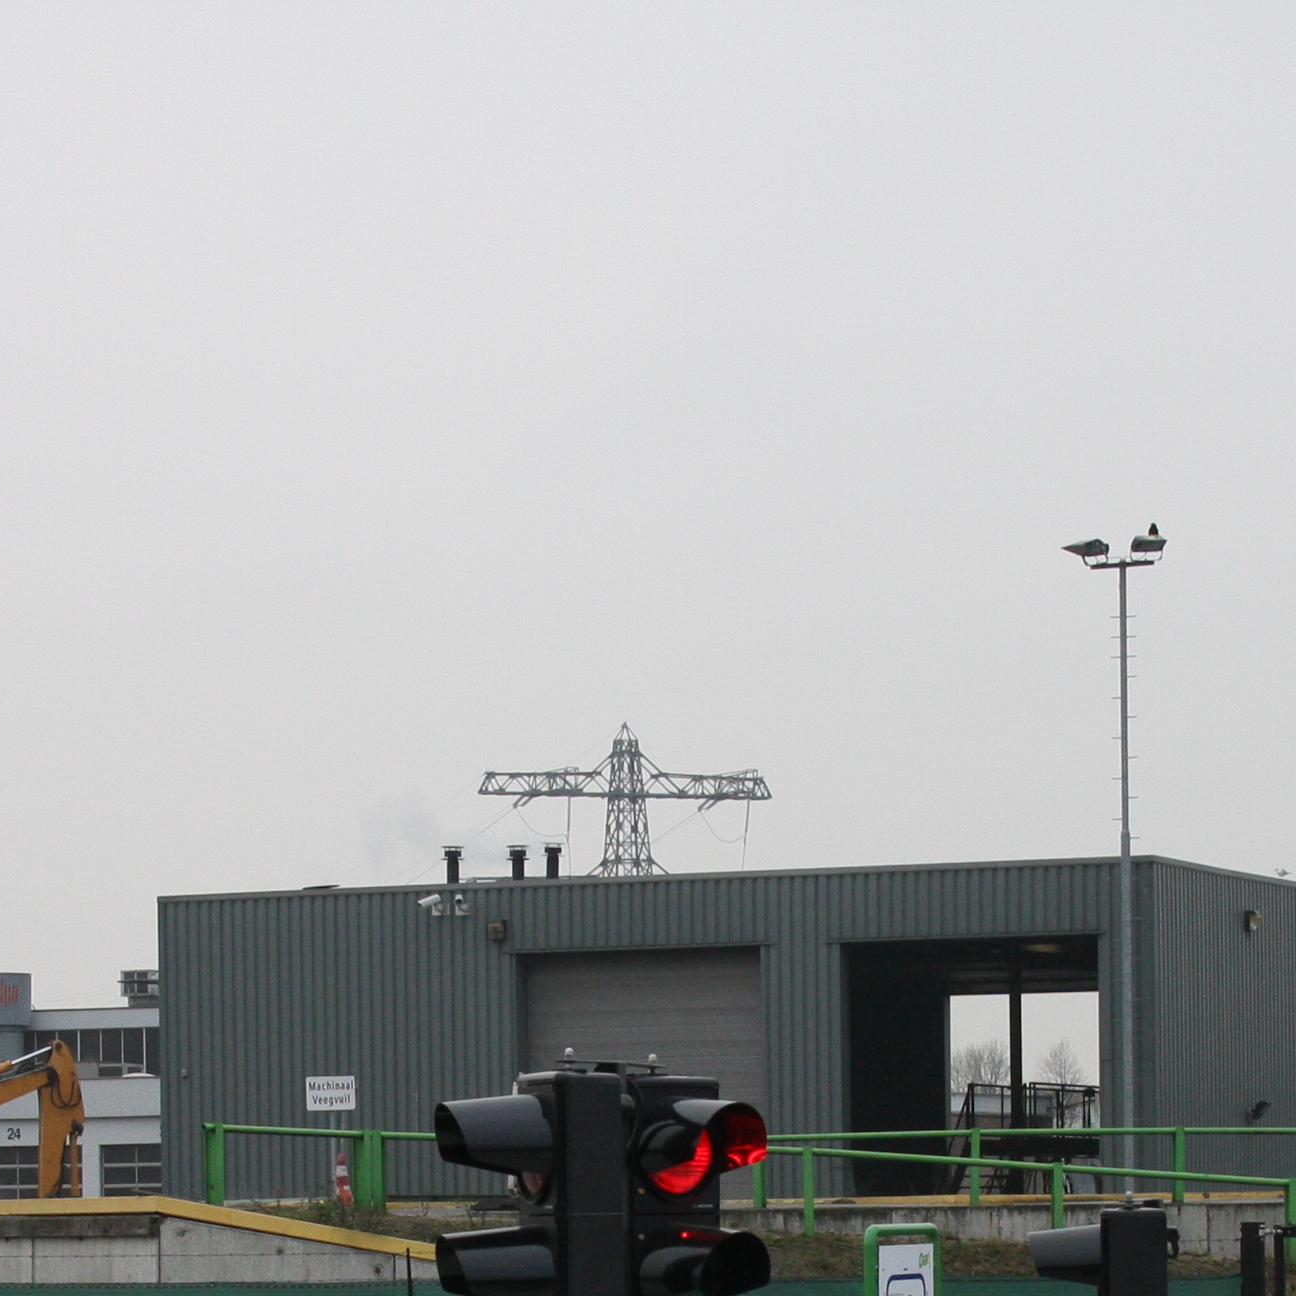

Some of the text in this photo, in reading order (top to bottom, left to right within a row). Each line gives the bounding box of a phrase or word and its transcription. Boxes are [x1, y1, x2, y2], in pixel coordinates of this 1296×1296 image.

[308, 1080, 354, 1091] Machinaal
[312, 1094, 351, 1107] Veegvuil
[7, 1127, 21, 1140] 24
